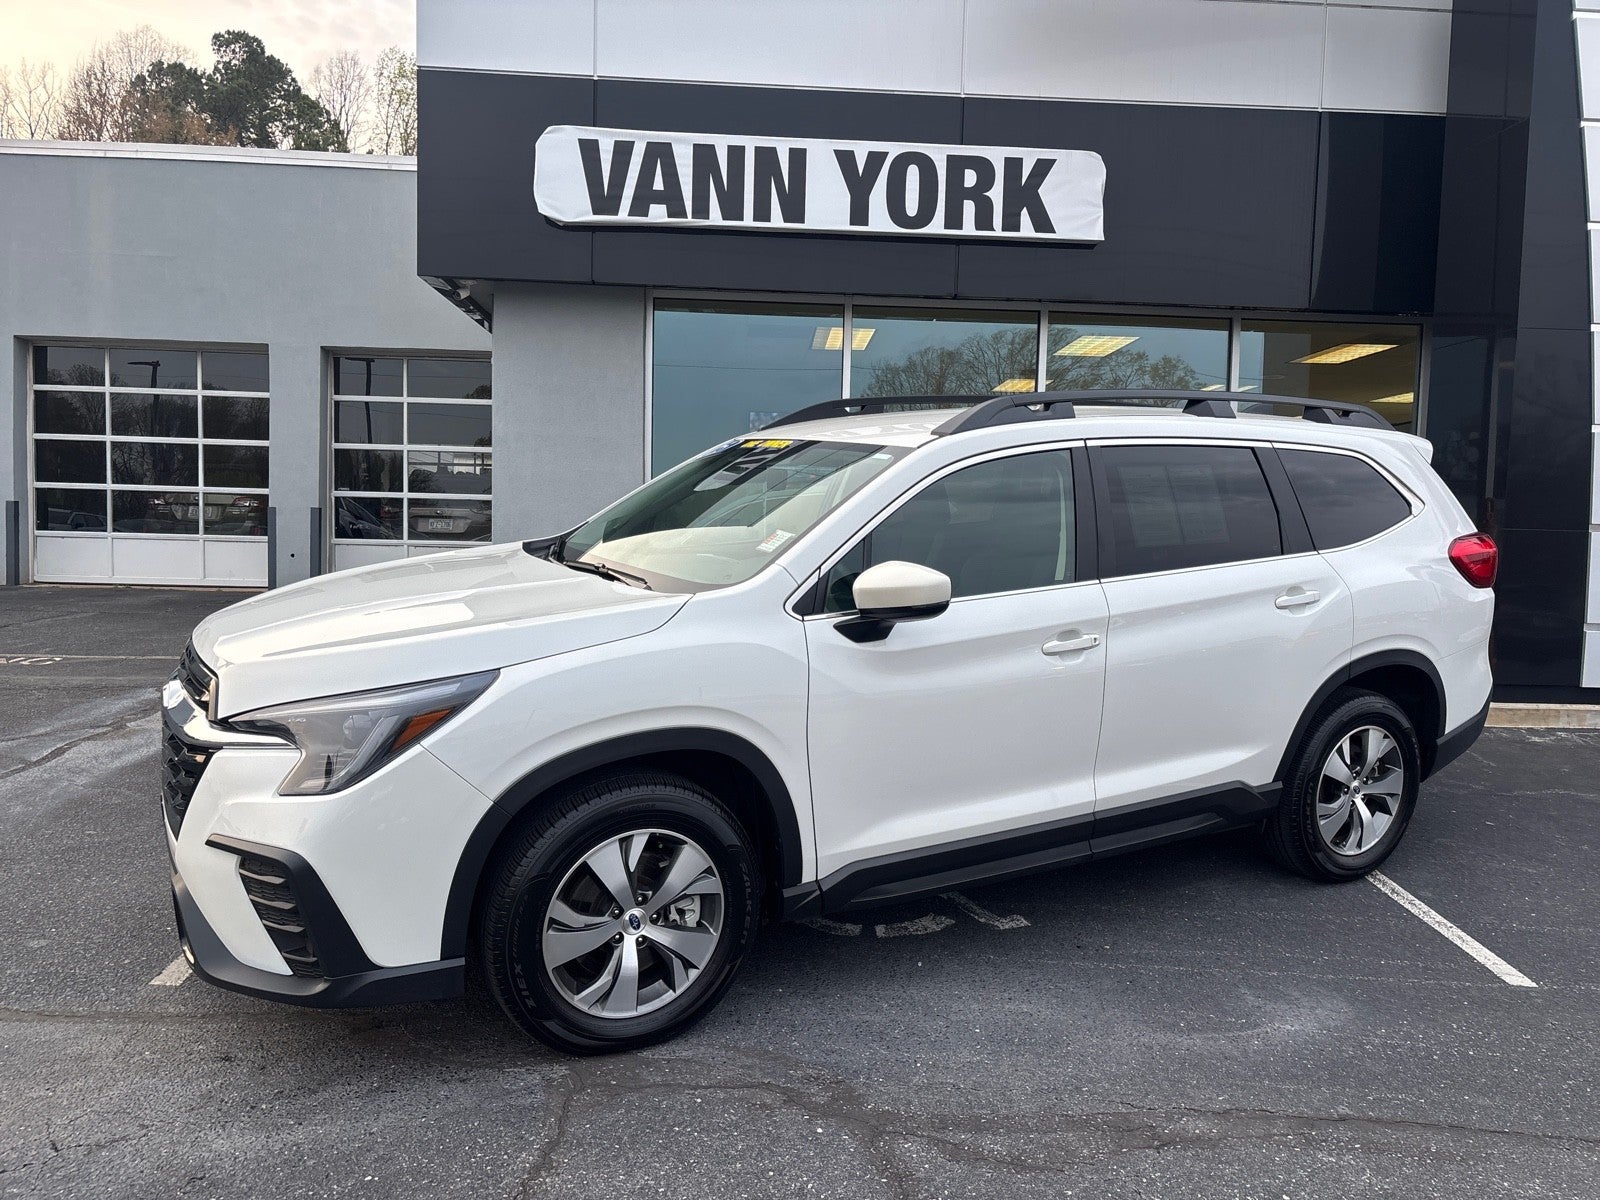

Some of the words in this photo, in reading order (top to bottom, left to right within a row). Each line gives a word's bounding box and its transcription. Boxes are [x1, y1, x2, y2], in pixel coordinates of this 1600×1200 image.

[578, 138, 807, 224] VANN
[833, 149, 1057, 233] YORK
[512, 963, 537, 1009] ZIEX
